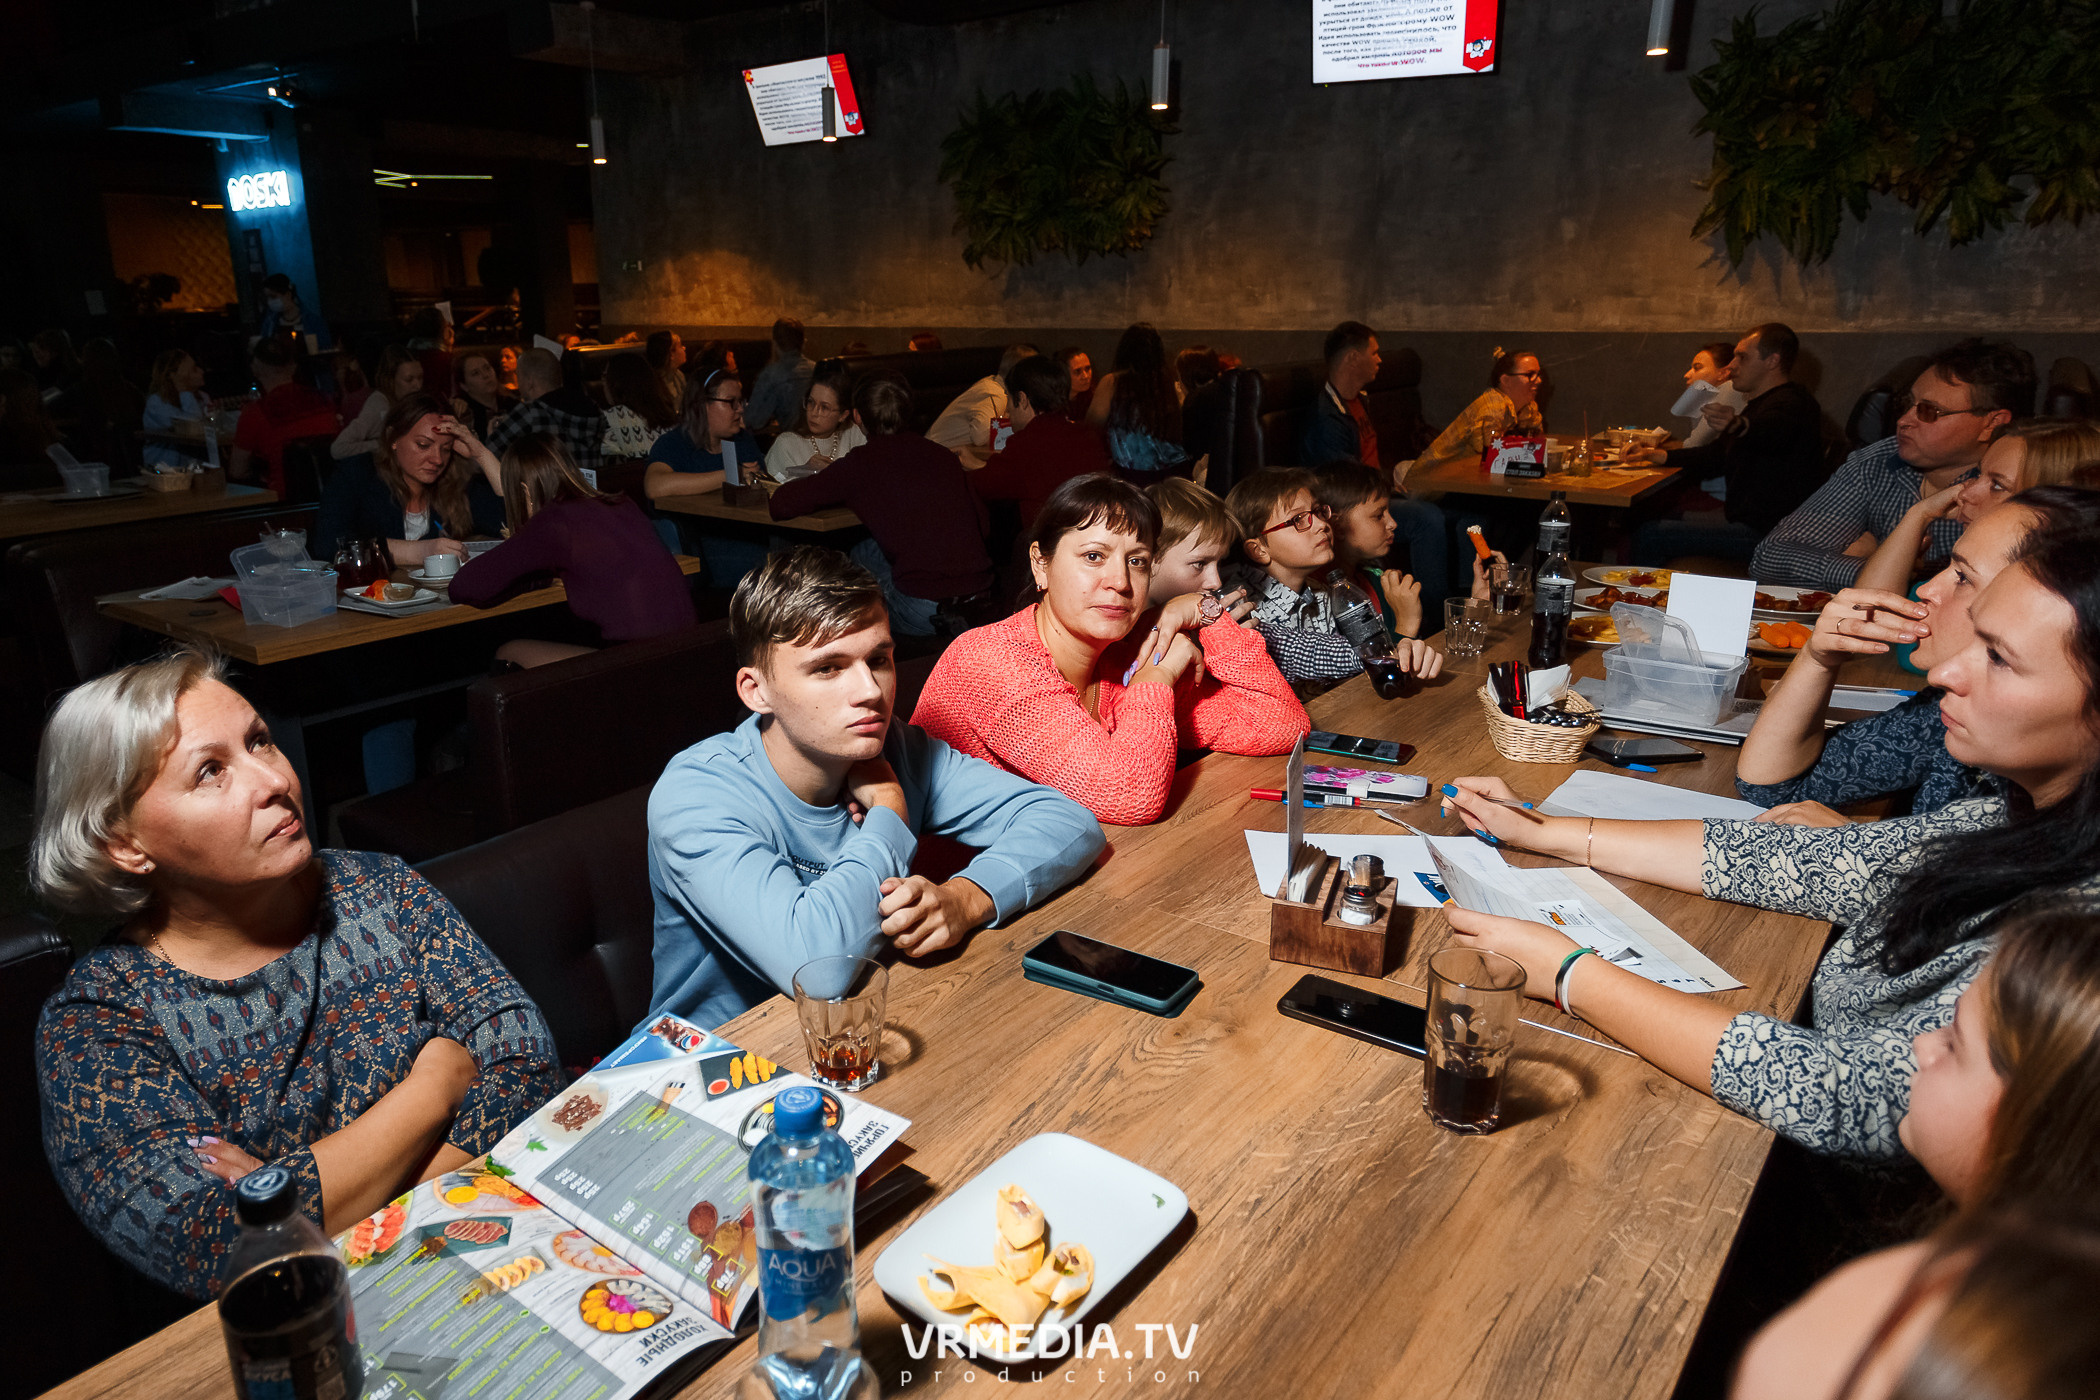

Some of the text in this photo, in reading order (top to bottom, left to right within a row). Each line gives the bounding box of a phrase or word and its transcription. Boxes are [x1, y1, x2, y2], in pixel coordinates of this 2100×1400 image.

[1429, 13, 1455, 22] WOW
[792, 855, 825, 868] OUTPUT
[613, 1200, 634, 1221] 257р
[768, 1252, 836, 1279] AQUA
[637, 1314, 694, 1347] ЗАКУСКИ
[635, 1323, 707, 1367] ХОЛОДНЫЕ
